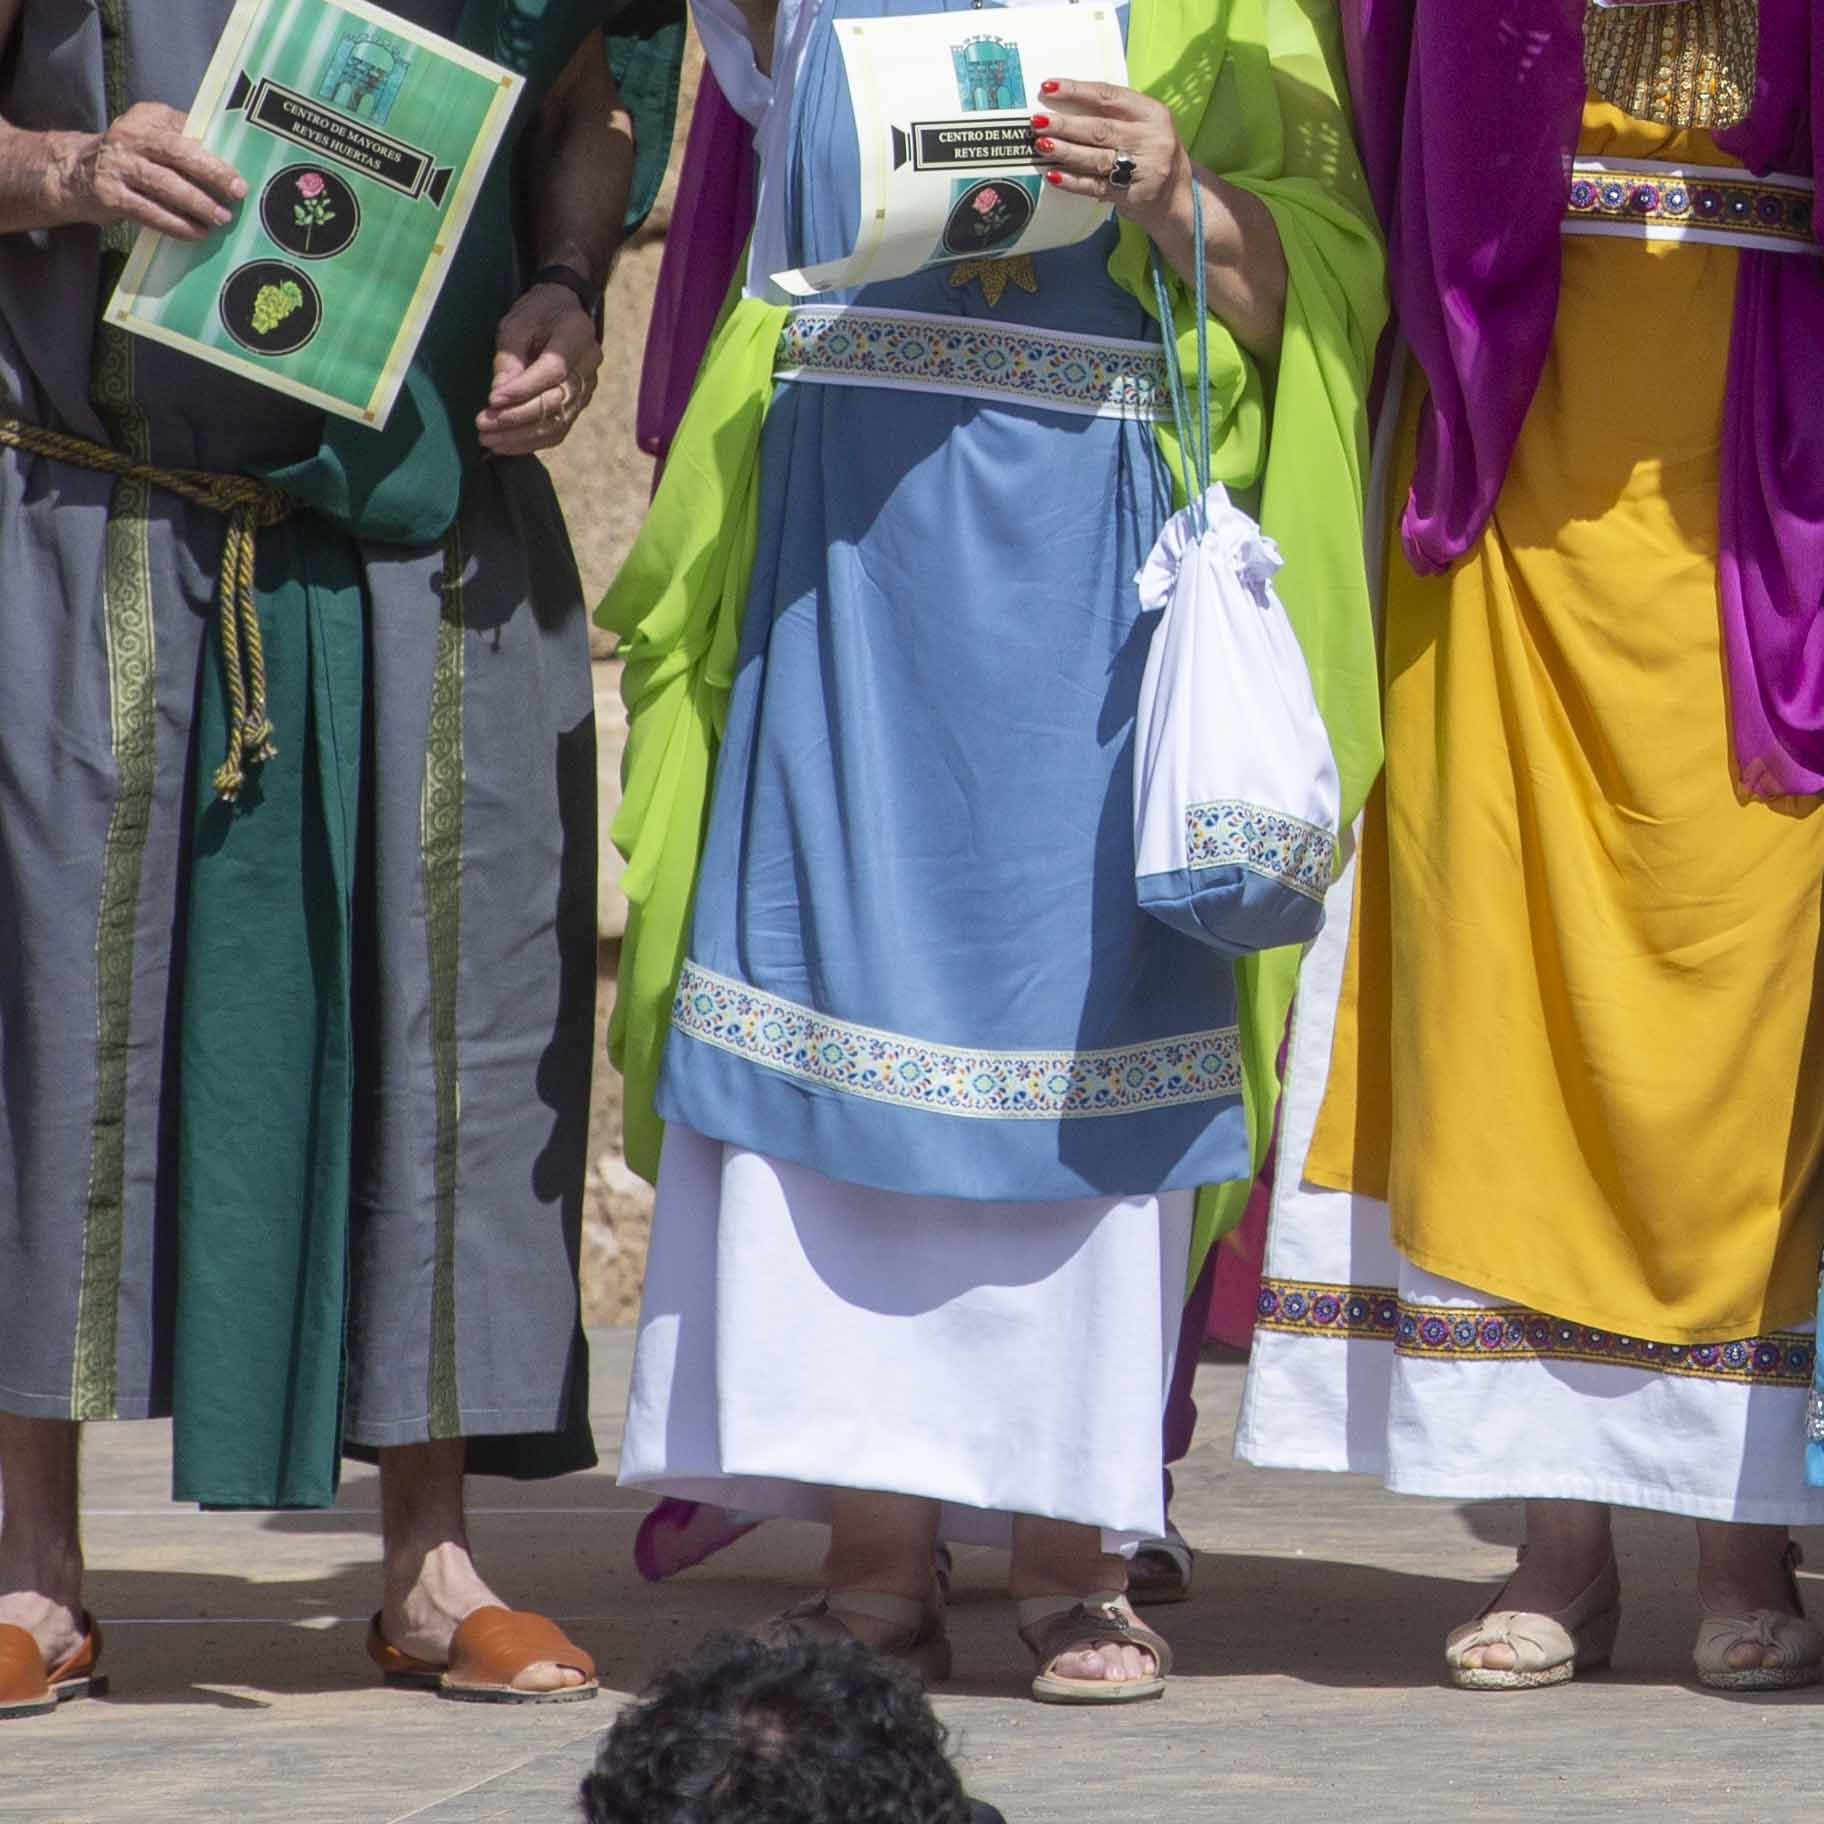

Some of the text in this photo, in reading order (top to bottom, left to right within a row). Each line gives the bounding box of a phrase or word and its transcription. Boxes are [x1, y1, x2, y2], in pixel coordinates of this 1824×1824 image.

[282, 100, 402, 162] CENTRO DE MAYORES
[292, 122, 382, 170] REYES HUERTAS
[939, 131, 984, 143] CENTRO
[985, 130, 1000, 141] DE
[954, 144, 1033, 159] REYES HUERTA
